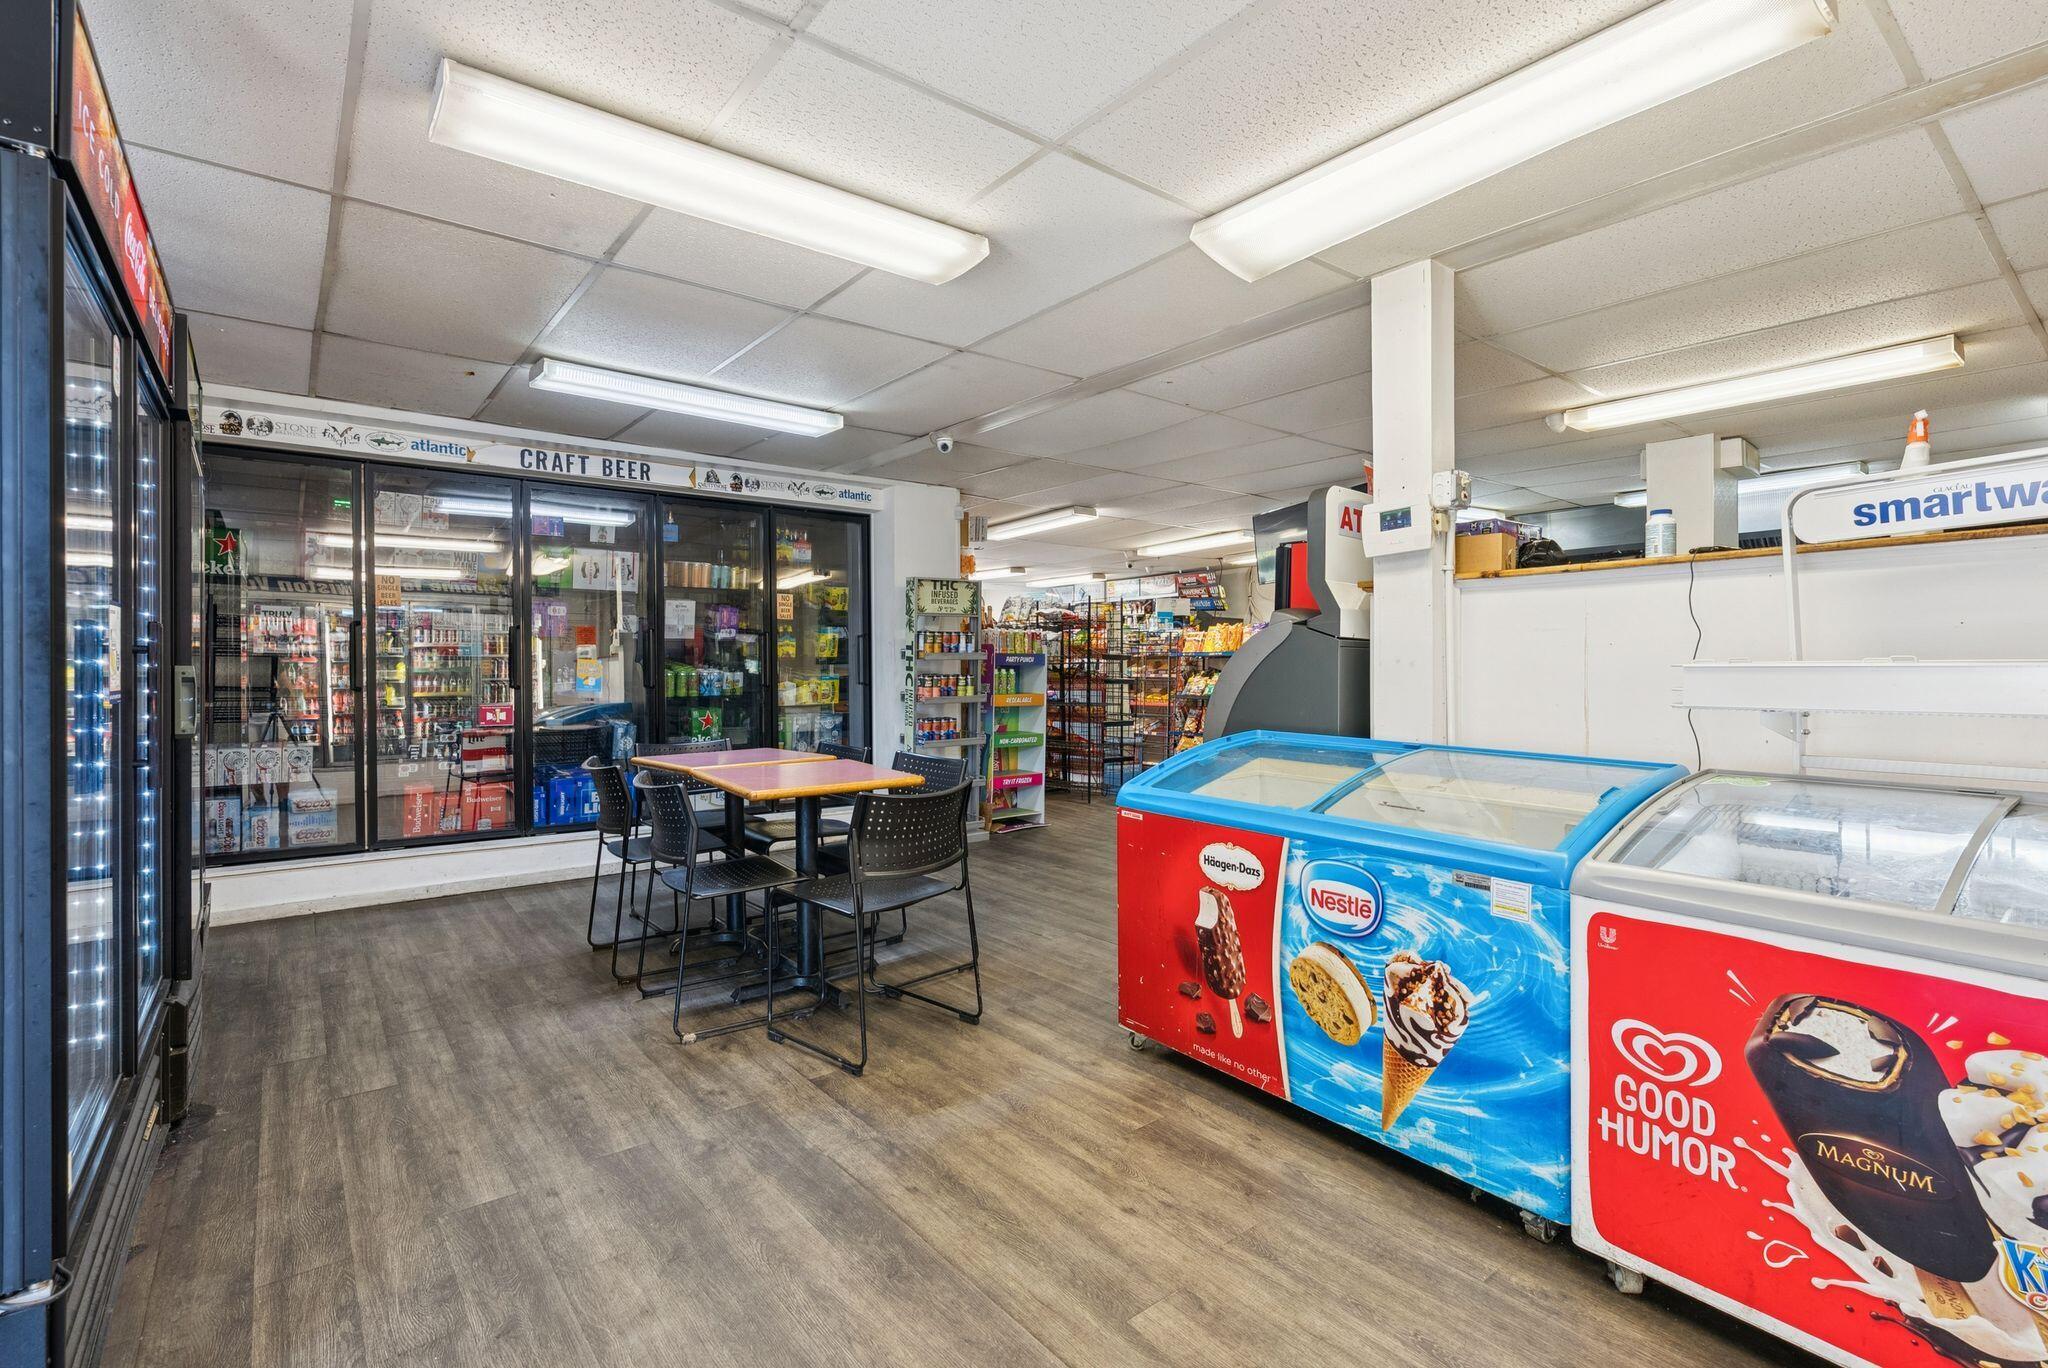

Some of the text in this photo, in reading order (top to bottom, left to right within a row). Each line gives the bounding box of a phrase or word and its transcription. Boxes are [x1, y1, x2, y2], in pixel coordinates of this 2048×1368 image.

[78, 89, 119, 219] ICE COLD
[275, 421, 318, 434] STONE
[410, 439, 467, 457] atlantic
[520, 448, 651, 482] CRAFT BEER
[838, 489, 872, 502] atlantic
[1853, 480, 2048, 527] smartw
[1340, 505, 1362, 533] AT
[381, 576, 396, 585] NO
[931, 580, 959, 590] THC
[931, 591, 959, 599] INFUSED
[905, 641, 914, 687] THC
[999, 736, 1038, 744] NON-CARBONATED
[295, 799, 331, 809] Coors
[413, 792, 423, 833] Budweiser
[256, 817, 267, 847] Coors
[295, 829, 333, 840] Coors
[1192, 1043, 1216, 1059] made
[1217, 1052, 1232, 1066] like
[1233, 1061, 1245, 1072] no
[1614, 1073, 1717, 1137] GOOD
[1597, 1106, 1740, 1190] HUMOR
[1816, 1139, 1936, 1194] MAGNUM
